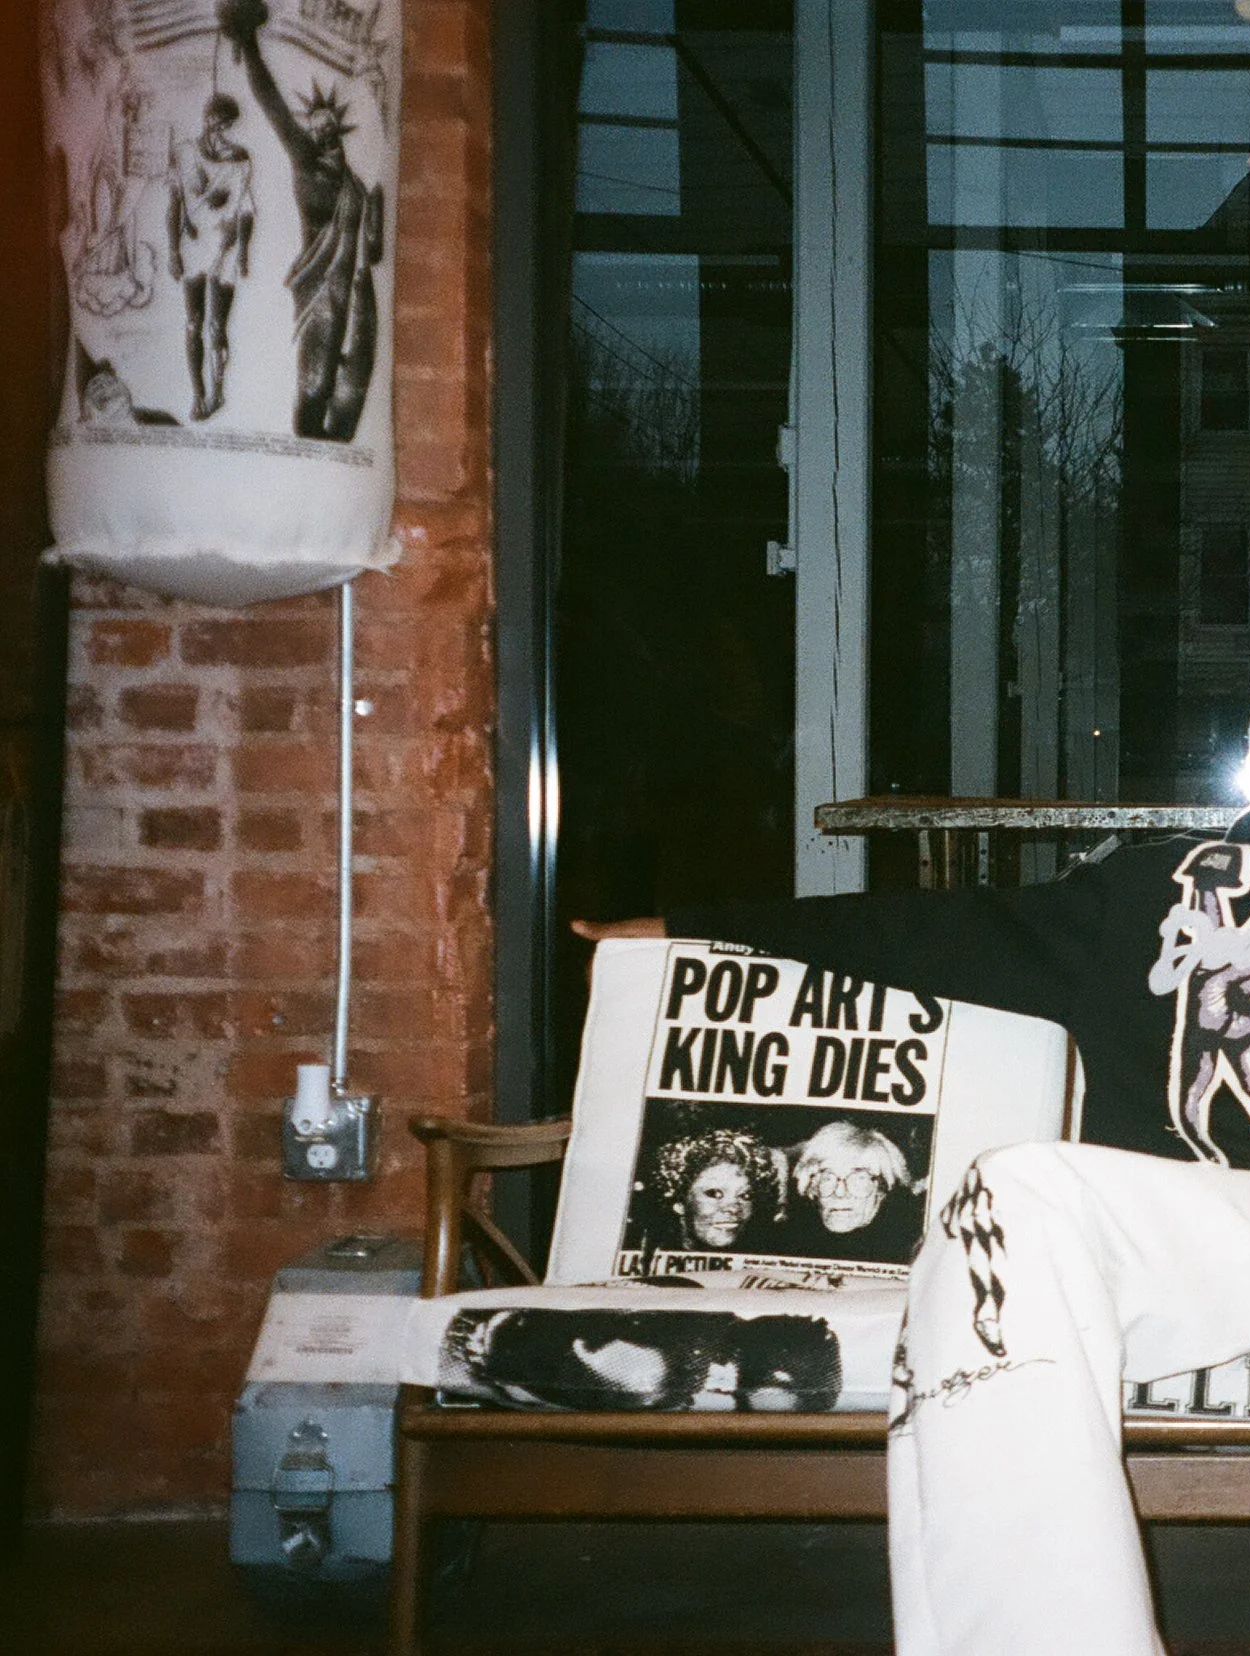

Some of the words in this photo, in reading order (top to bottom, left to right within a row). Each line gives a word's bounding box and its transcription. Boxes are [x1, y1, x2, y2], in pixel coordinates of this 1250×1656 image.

[666, 957, 779, 1023] POP
[788, 964, 944, 1034] ARTS
[659, 1027, 789, 1097] KING
[808, 1034, 929, 1106] DIES
[618, 1254, 661, 1276] LAT
